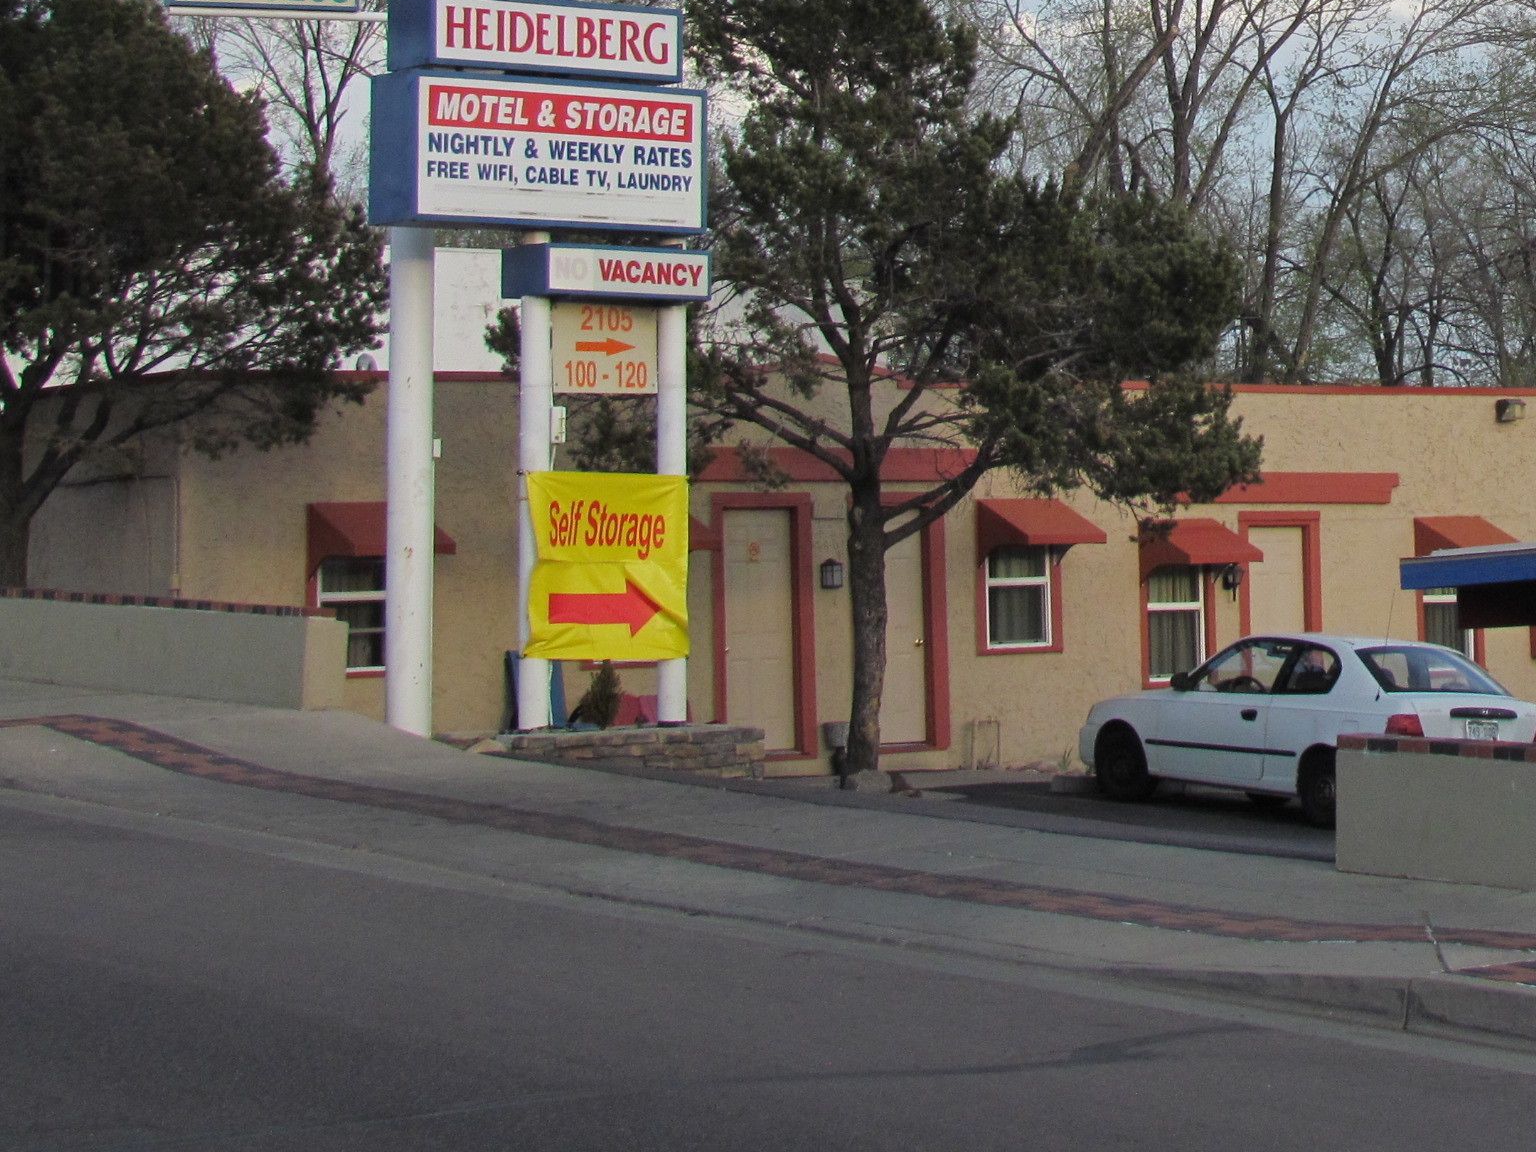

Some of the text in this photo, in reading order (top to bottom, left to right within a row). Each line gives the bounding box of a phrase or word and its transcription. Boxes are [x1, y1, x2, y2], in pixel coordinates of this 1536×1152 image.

[445, 4, 669, 65] HEIDELBERG
[436, 91, 687, 136] MOTEL & STORAGE
[428, 132, 693, 169] NIGHTLY & WEEKLY RATES
[427, 160, 693, 193] FREE WIFI, CABLE TV, LAUNDRY
[555, 256, 704, 287] NO VACANCY
[580, 304, 633, 332] 2105
[565, 360, 597, 388] 100
[615, 360, 648, 389] 120
[549, 499, 666, 560] Self Storage
